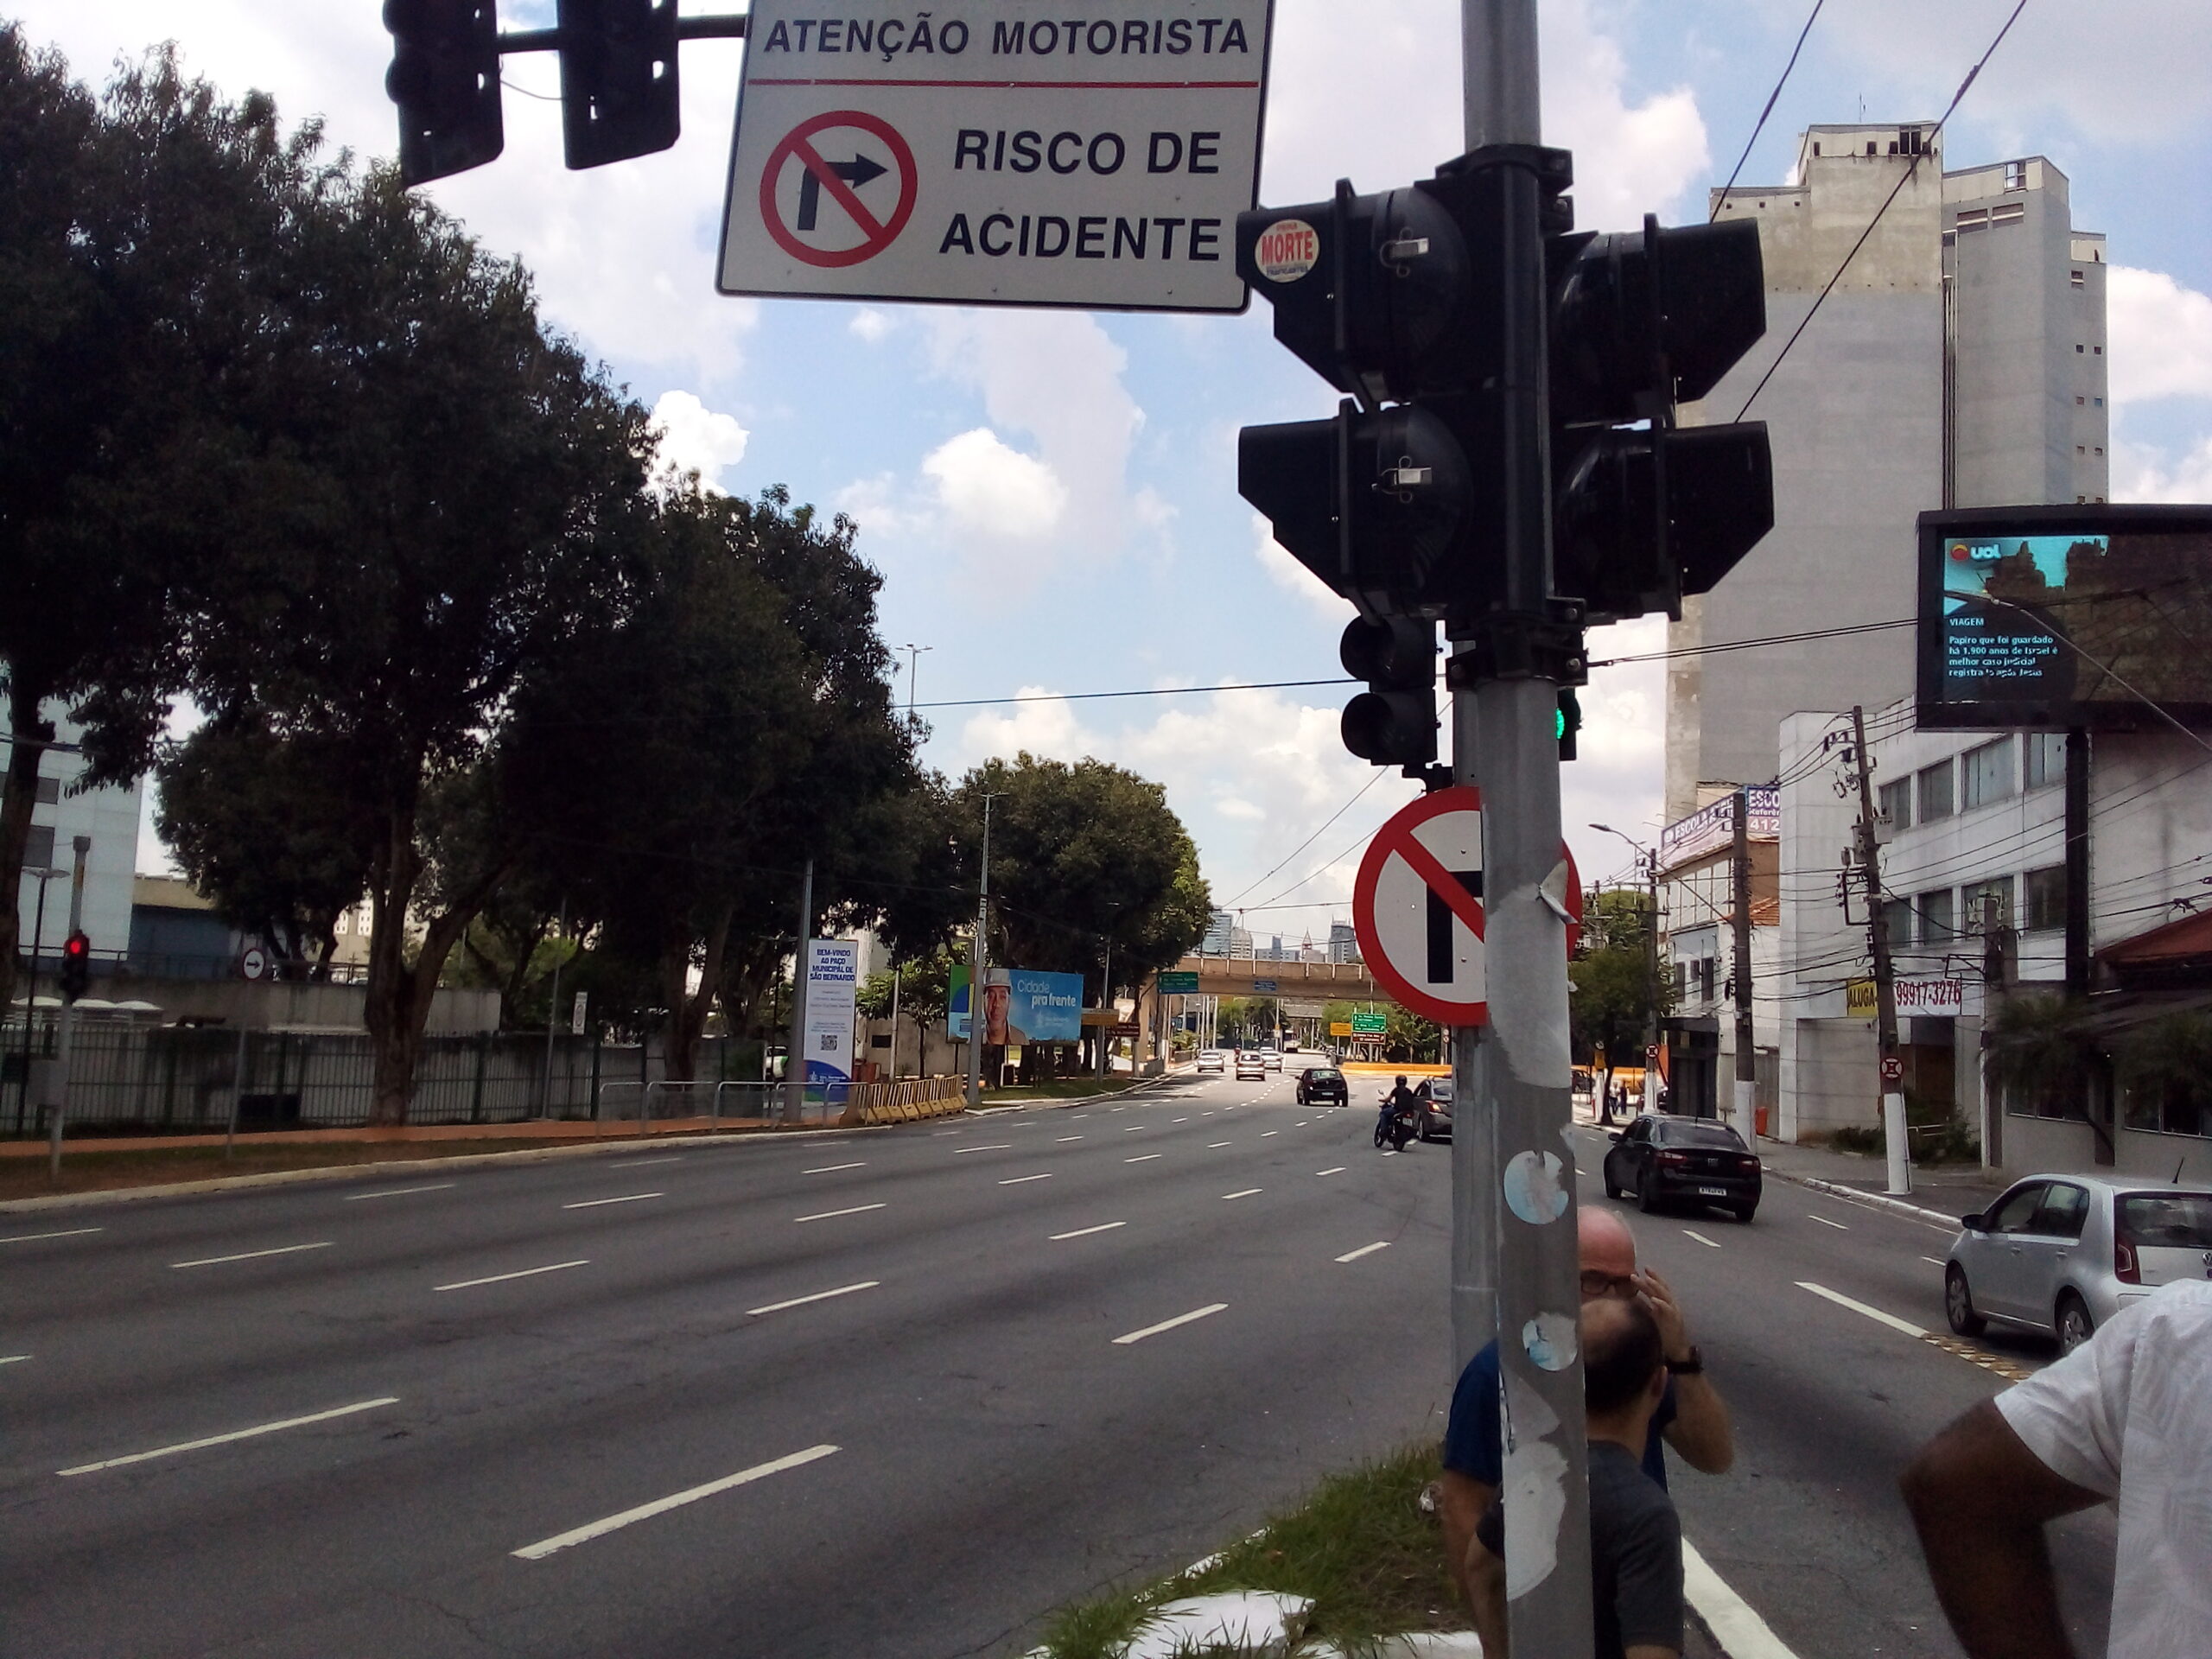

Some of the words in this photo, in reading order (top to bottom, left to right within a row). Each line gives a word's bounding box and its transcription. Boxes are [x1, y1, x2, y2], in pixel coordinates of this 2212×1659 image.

[764, 12, 969, 62] ATENÇÃO
[992, 18, 1249, 54] MOTORISTA
[953, 129, 1125, 175] RISCO
[1147, 131, 1221, 174] DE
[938, 213, 1222, 261] ACIDENTE
[1262, 231, 1313, 265] MORTE
[1949, 618, 1984, 626] VIAGEM
[1948, 636, 1977, 645] Papiro
[1998, 635, 2009, 644] foi
[2012, 635, 2054, 645] guardado
[1948, 646, 1960, 655] há
[1963, 646, 1986, 655] 1.900
[2012, 646, 2022, 655] de
[1948, 657, 1979, 665] melhor
[1750, 818, 1780, 830] 412
[1017, 979, 1050, 994] Cidade
[1032, 995, 1047, 1009] pra
[1048, 993, 1077, 1007] frente
